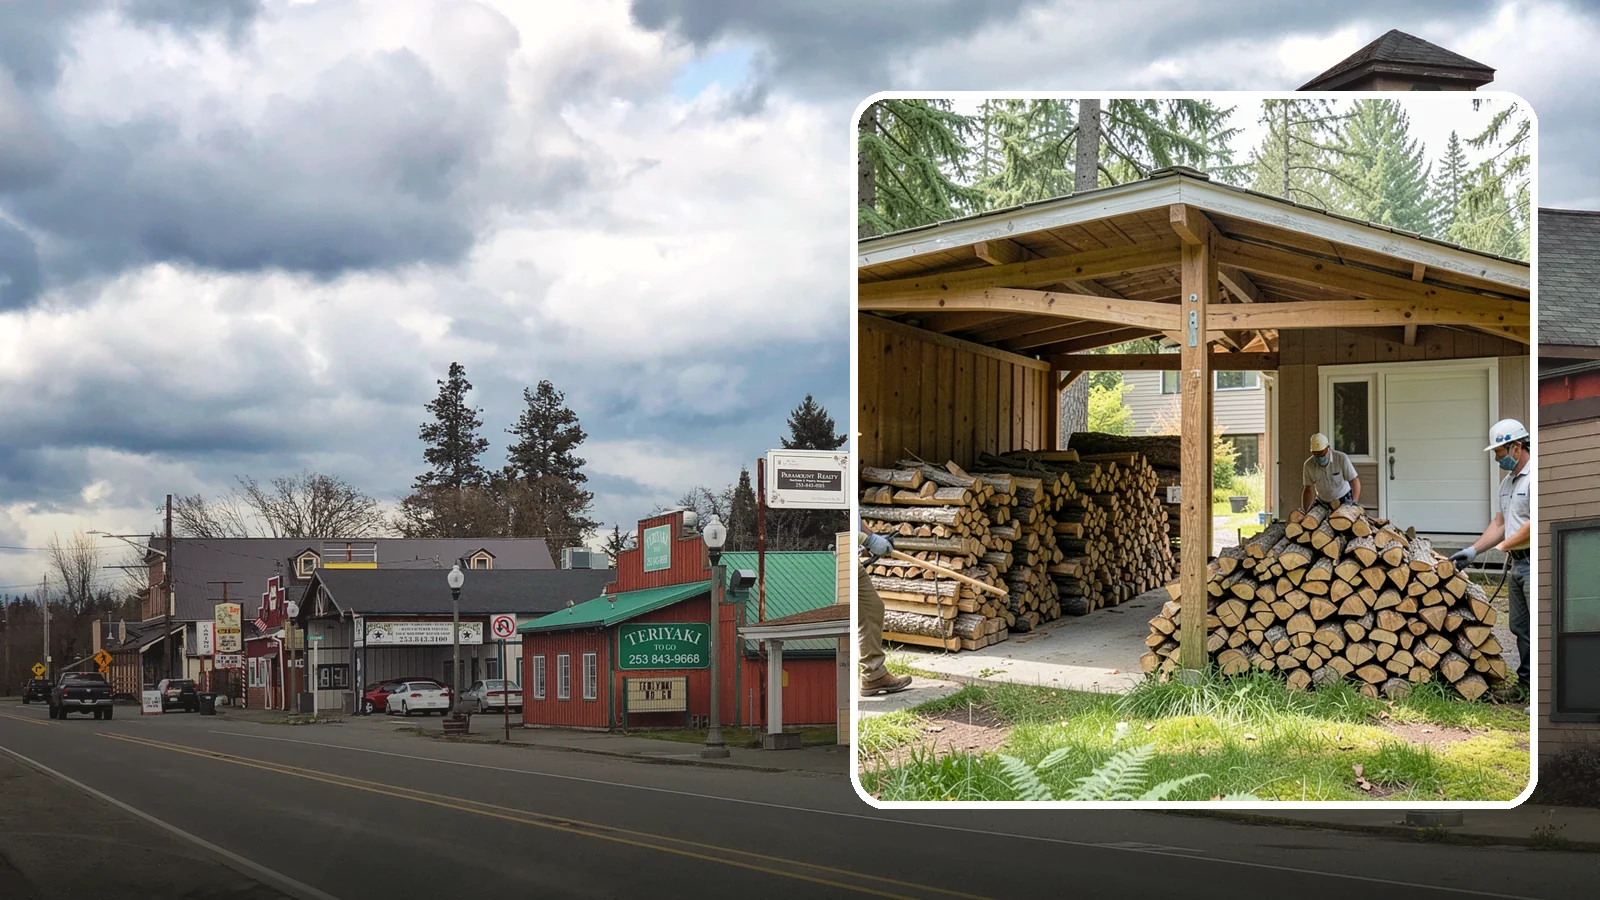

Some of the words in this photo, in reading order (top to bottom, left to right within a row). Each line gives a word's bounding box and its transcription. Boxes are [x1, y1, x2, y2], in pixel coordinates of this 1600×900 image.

[817, 472, 839, 480] REALTY
[625, 627, 702, 646] TERIYAKI
[629, 654, 648, 664] 253
[651, 654, 700, 664] 843-9668
[639, 681, 672, 690] TERIYAKI
